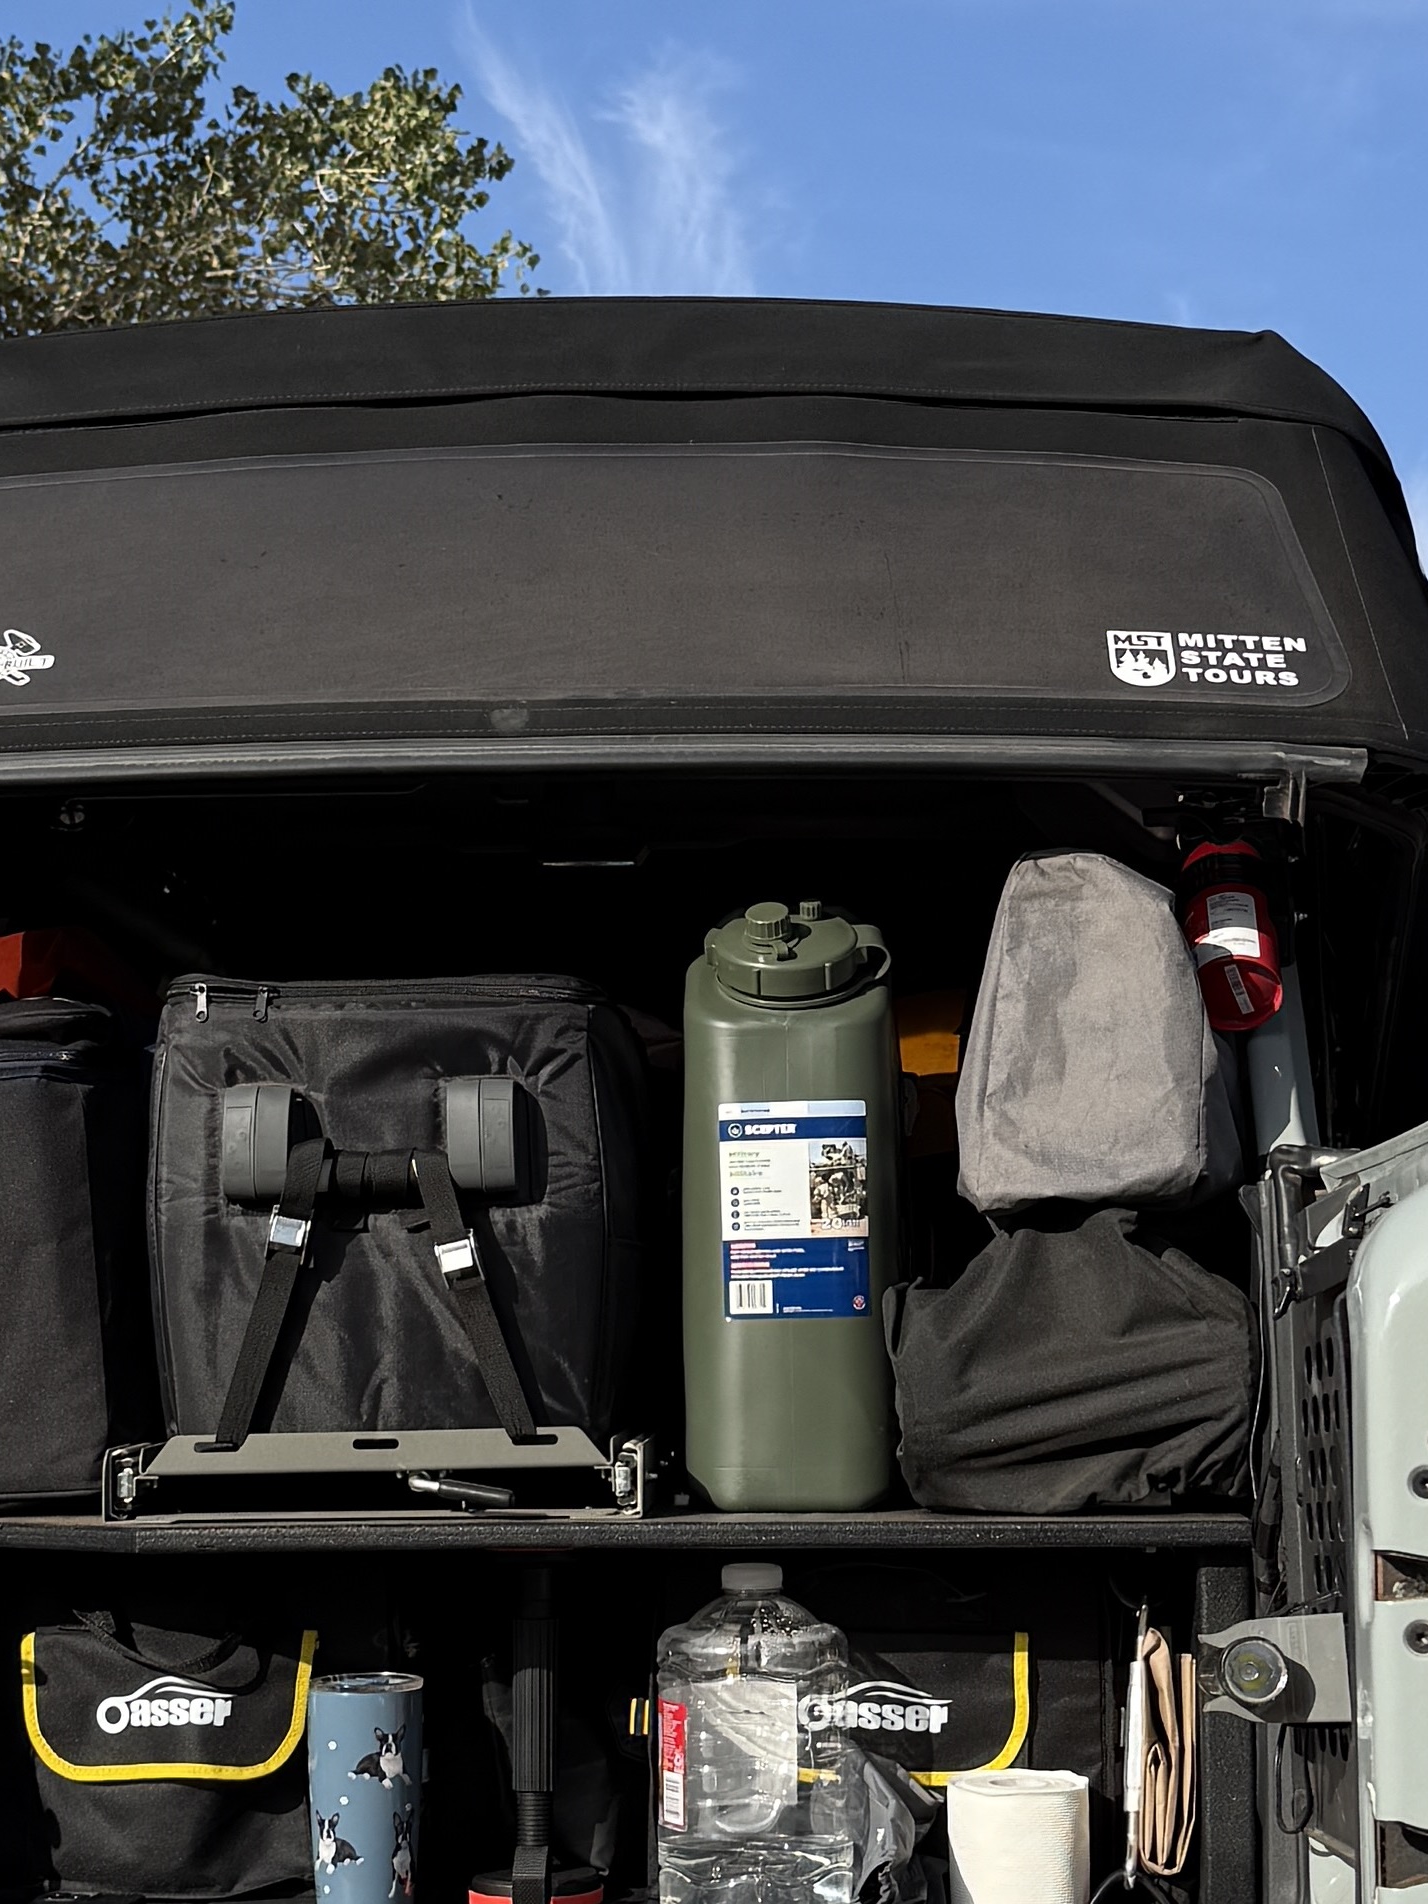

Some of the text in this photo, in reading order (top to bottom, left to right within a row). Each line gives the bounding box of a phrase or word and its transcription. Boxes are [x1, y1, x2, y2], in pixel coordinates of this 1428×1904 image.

[1113, 633, 1165, 647] MST
[1177, 632, 1307, 653] MITTEN
[1180, 650, 1287, 668] STATE
[1180, 667, 1300, 687] TOURS
[744, 1123, 798, 1136] SCEPTER
[96, 1690, 233, 1735] Oasser
